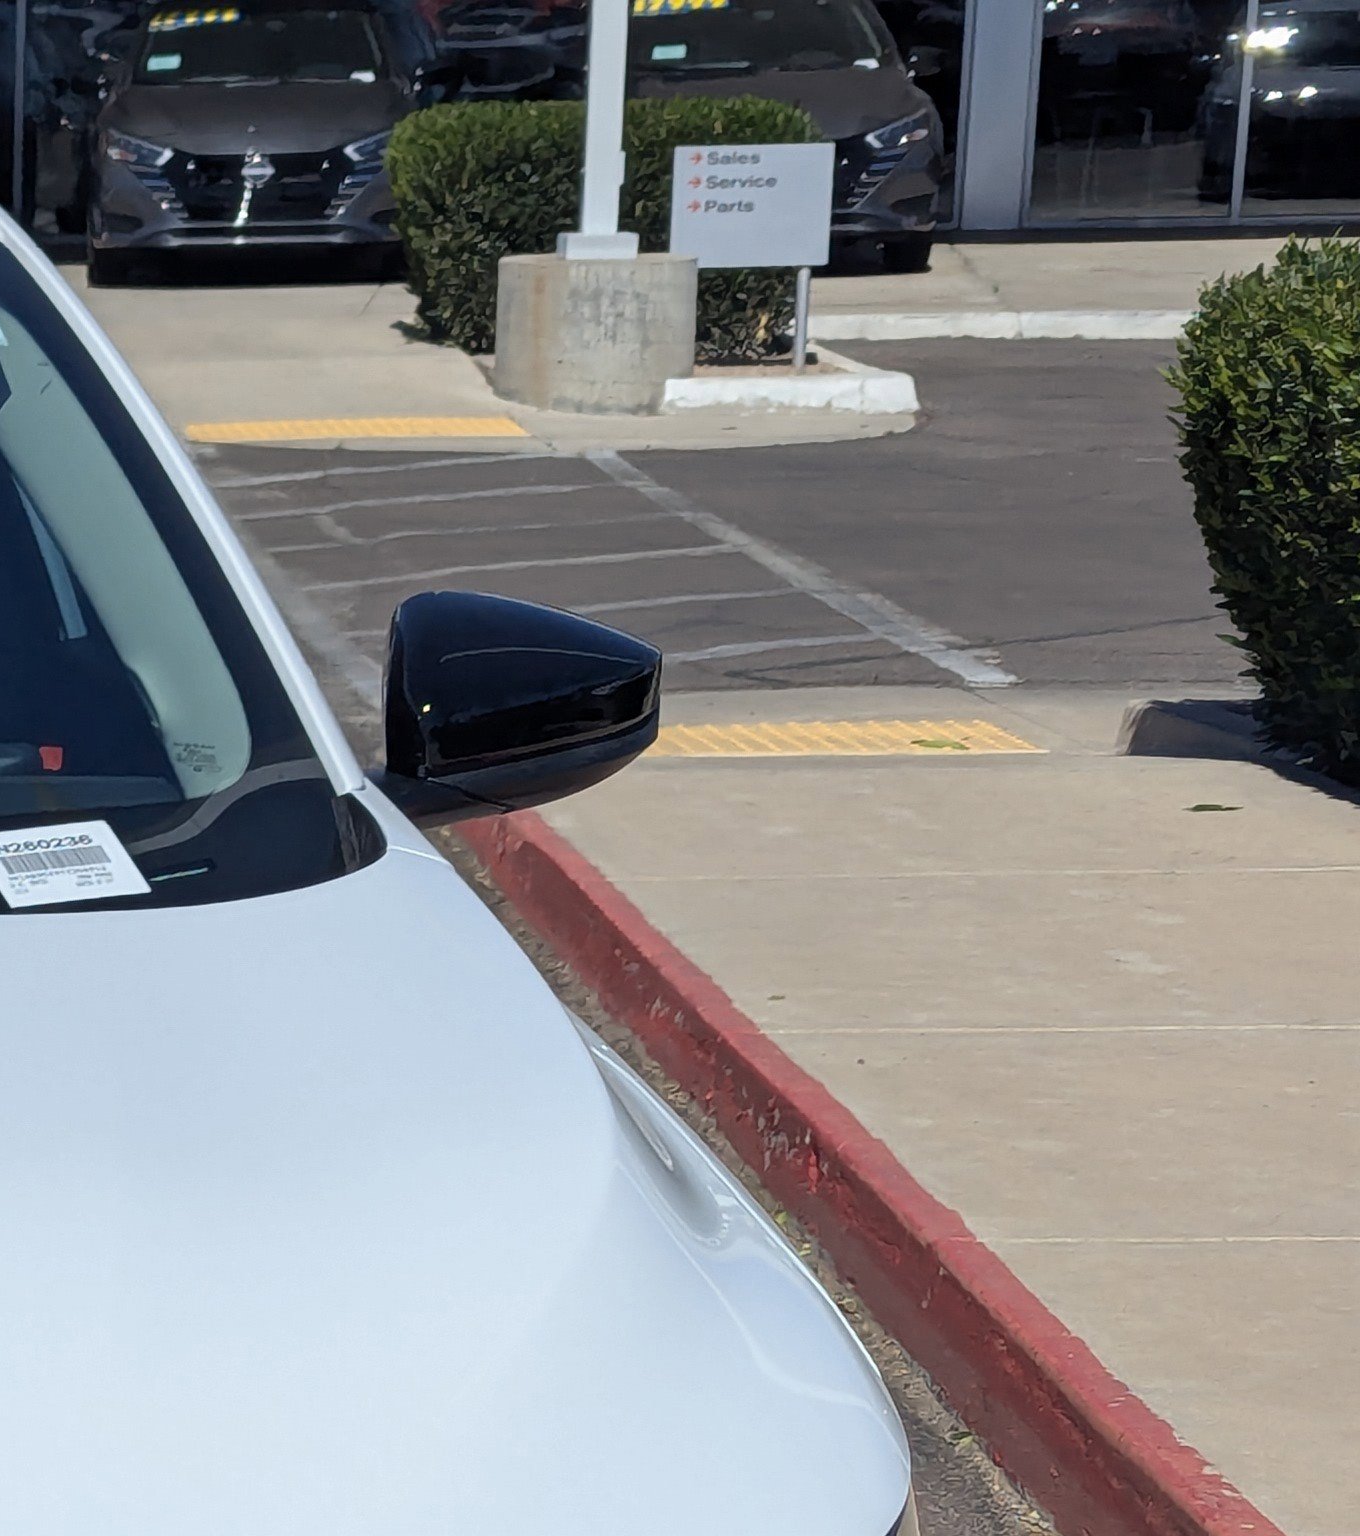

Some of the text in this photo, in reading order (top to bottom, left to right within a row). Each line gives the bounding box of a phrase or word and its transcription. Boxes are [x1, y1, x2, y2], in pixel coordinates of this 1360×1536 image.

[707, 151, 760, 165] Sales
[705, 175, 777, 189] Service
[704, 200, 754, 213] Parts
